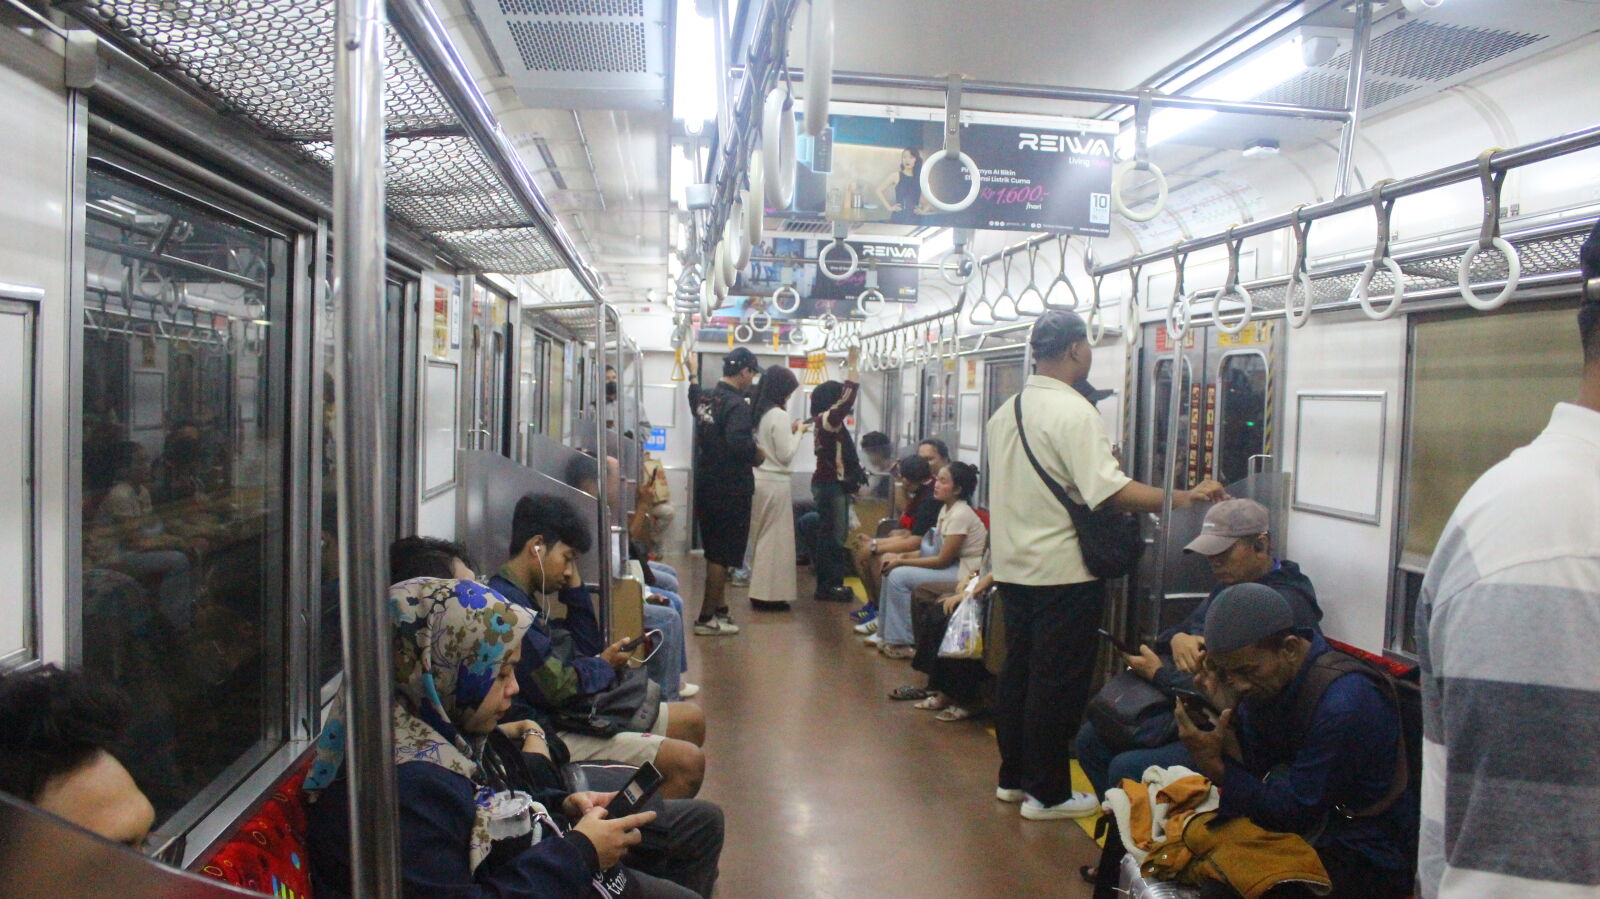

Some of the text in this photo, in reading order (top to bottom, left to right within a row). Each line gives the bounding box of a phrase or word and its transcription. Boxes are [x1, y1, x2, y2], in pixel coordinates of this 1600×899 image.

[1018, 132, 1111, 157] REIWA
[961, 167, 992, 175] Pinya
[991, 175, 1010, 183] Listrik
[1094, 194, 1107, 208] 10
[862, 245, 917, 258] REIWA
